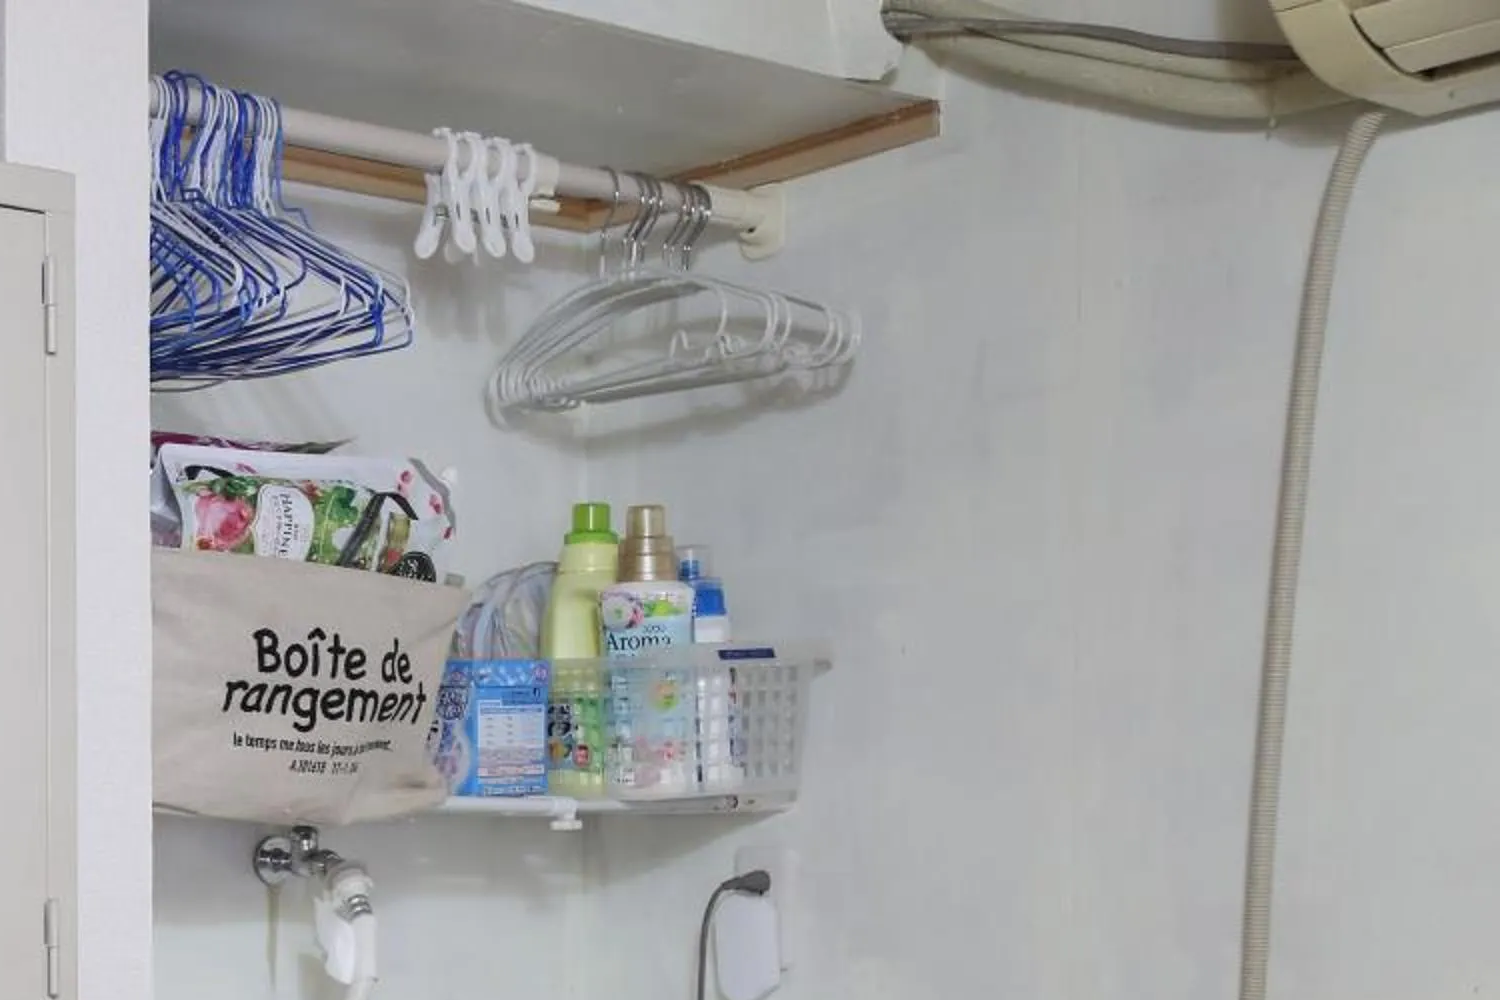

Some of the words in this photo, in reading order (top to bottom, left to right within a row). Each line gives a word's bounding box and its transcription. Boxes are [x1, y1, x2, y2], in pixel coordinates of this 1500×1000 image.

[253, 627, 367, 680] Boîte
[382, 638, 412, 683] de
[608, 632, 671, 651] Aroma
[221, 680, 427, 732] rangement
[246, 734, 277, 751] temps
